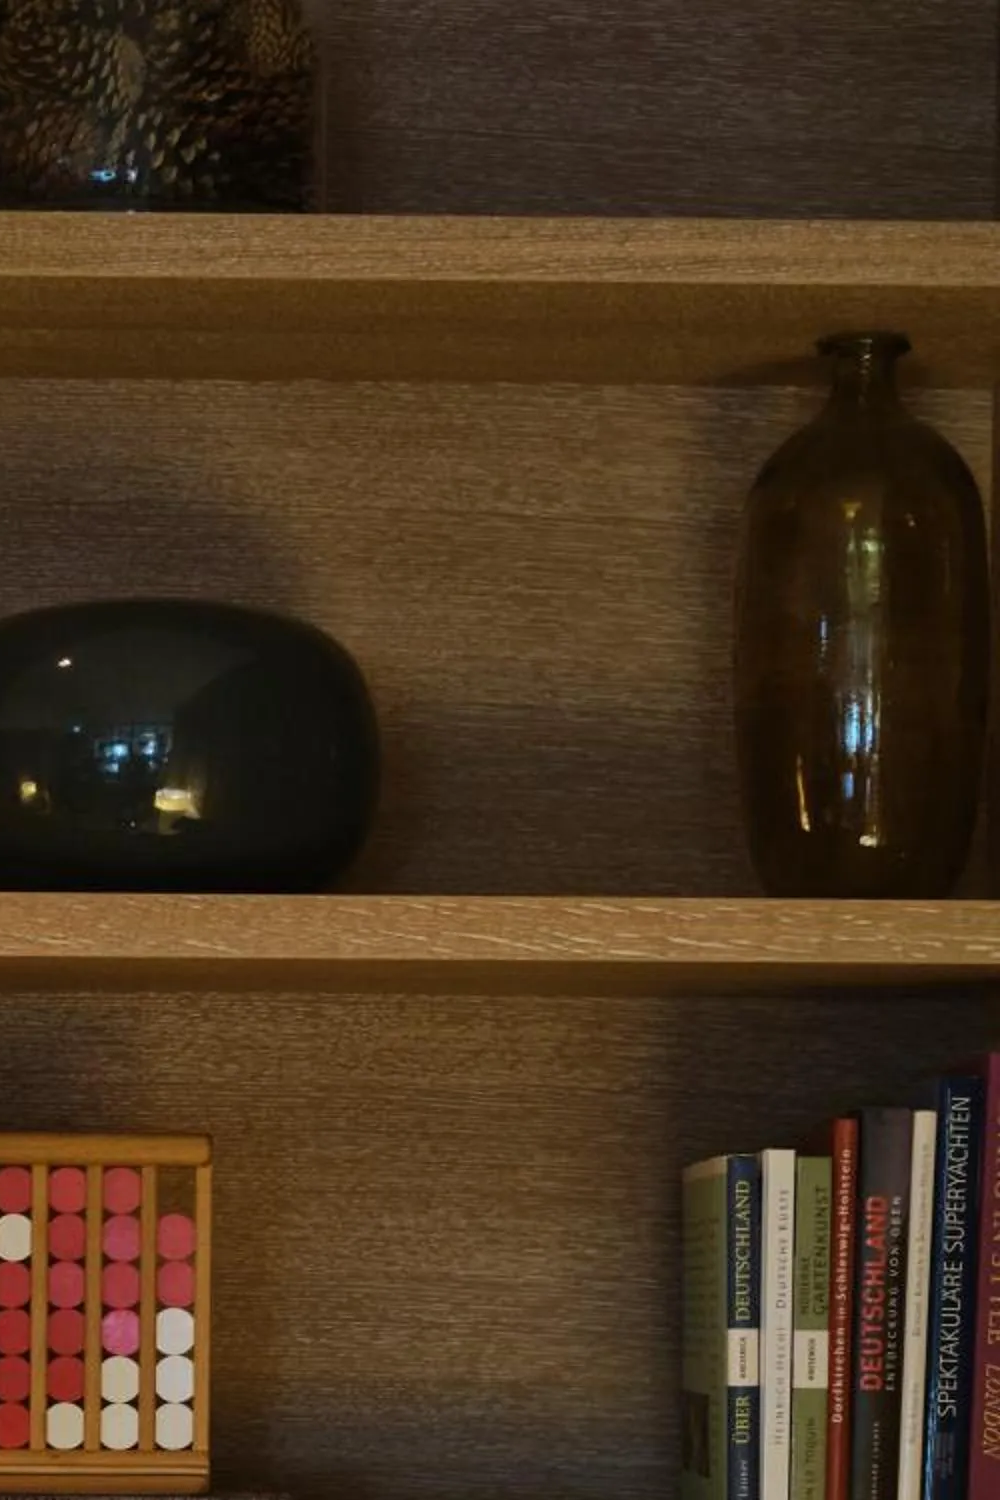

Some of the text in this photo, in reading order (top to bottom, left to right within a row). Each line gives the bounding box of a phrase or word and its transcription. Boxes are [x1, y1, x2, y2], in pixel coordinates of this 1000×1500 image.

[835, 1148, 855, 1301] Schleswig-Holstein
[943, 1097, 972, 1254] SUPERYACHTEN
[735, 1179, 751, 1322] DEUTSCHLAND
[812, 1186, 827, 1315] GARTENKUNST
[861, 1195, 889, 1392] DEUTSCHLAND
[885, 1195, 900, 1390] ENTDECKUNG VON OBEN
[831, 1327, 846, 1423] Dorfkirchen
[937, 1261, 964, 1418] SPEKTAKULÄRE
[982, 1363, 1000, 1458] LONDON
[731, 1397, 751, 1445] ÜBER
